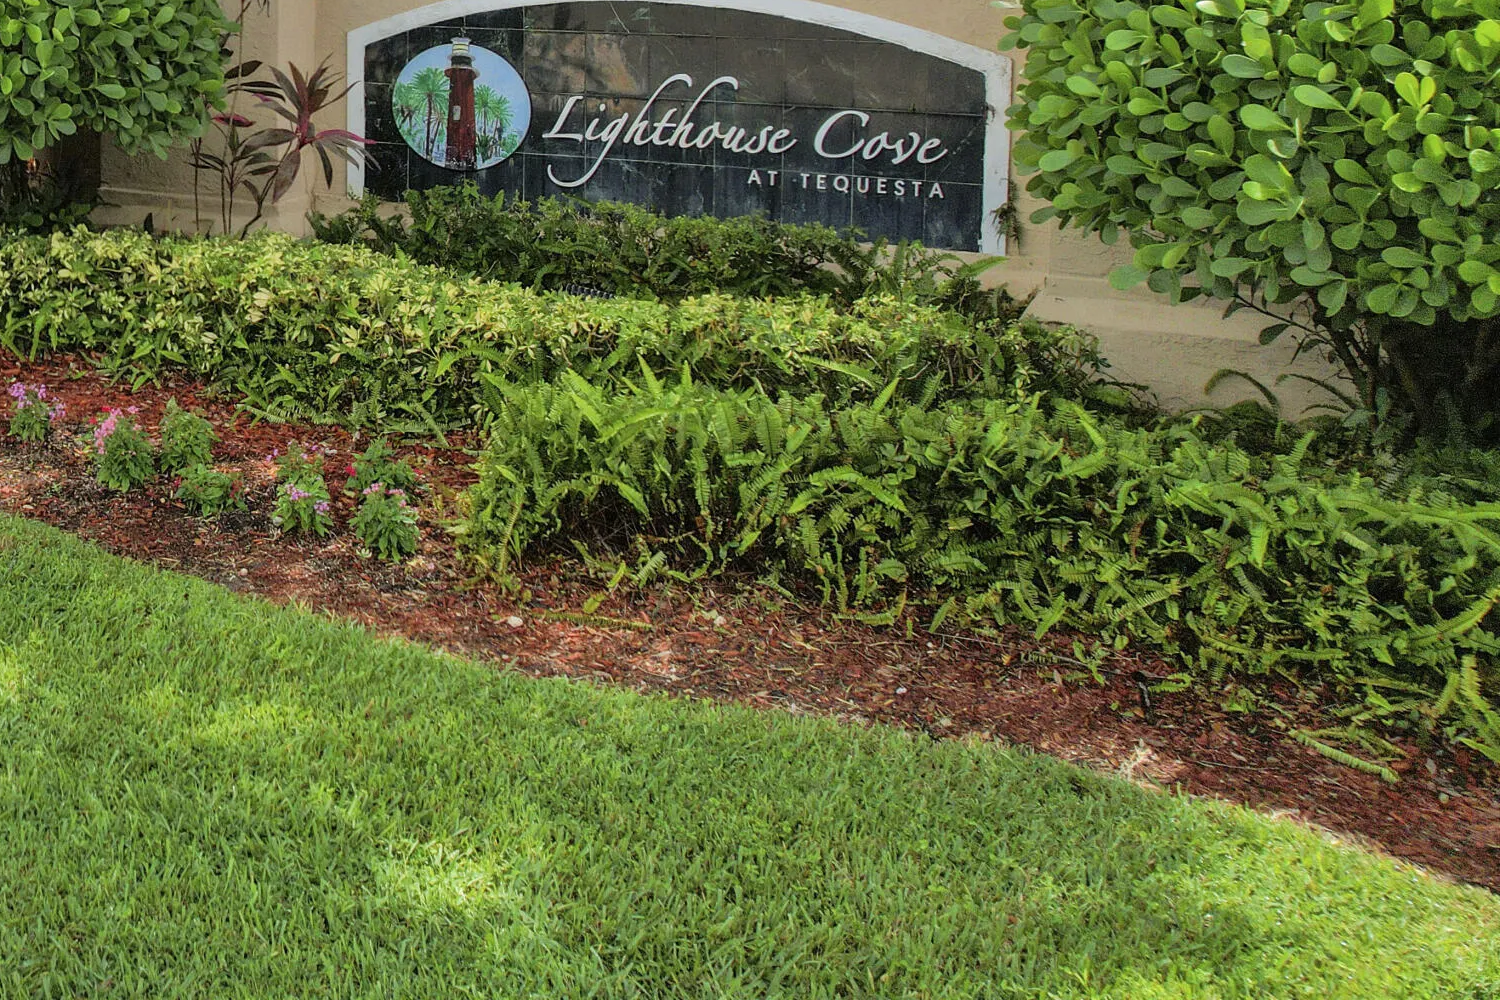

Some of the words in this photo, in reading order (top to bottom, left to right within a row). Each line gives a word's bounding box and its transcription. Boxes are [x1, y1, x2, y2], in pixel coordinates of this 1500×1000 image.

[542, 74, 798, 188] Lighthouse
[814, 110, 948, 164] Cove
[748, 170, 778, 186] AT
[801, 173, 944, 198] TEQUESTA
